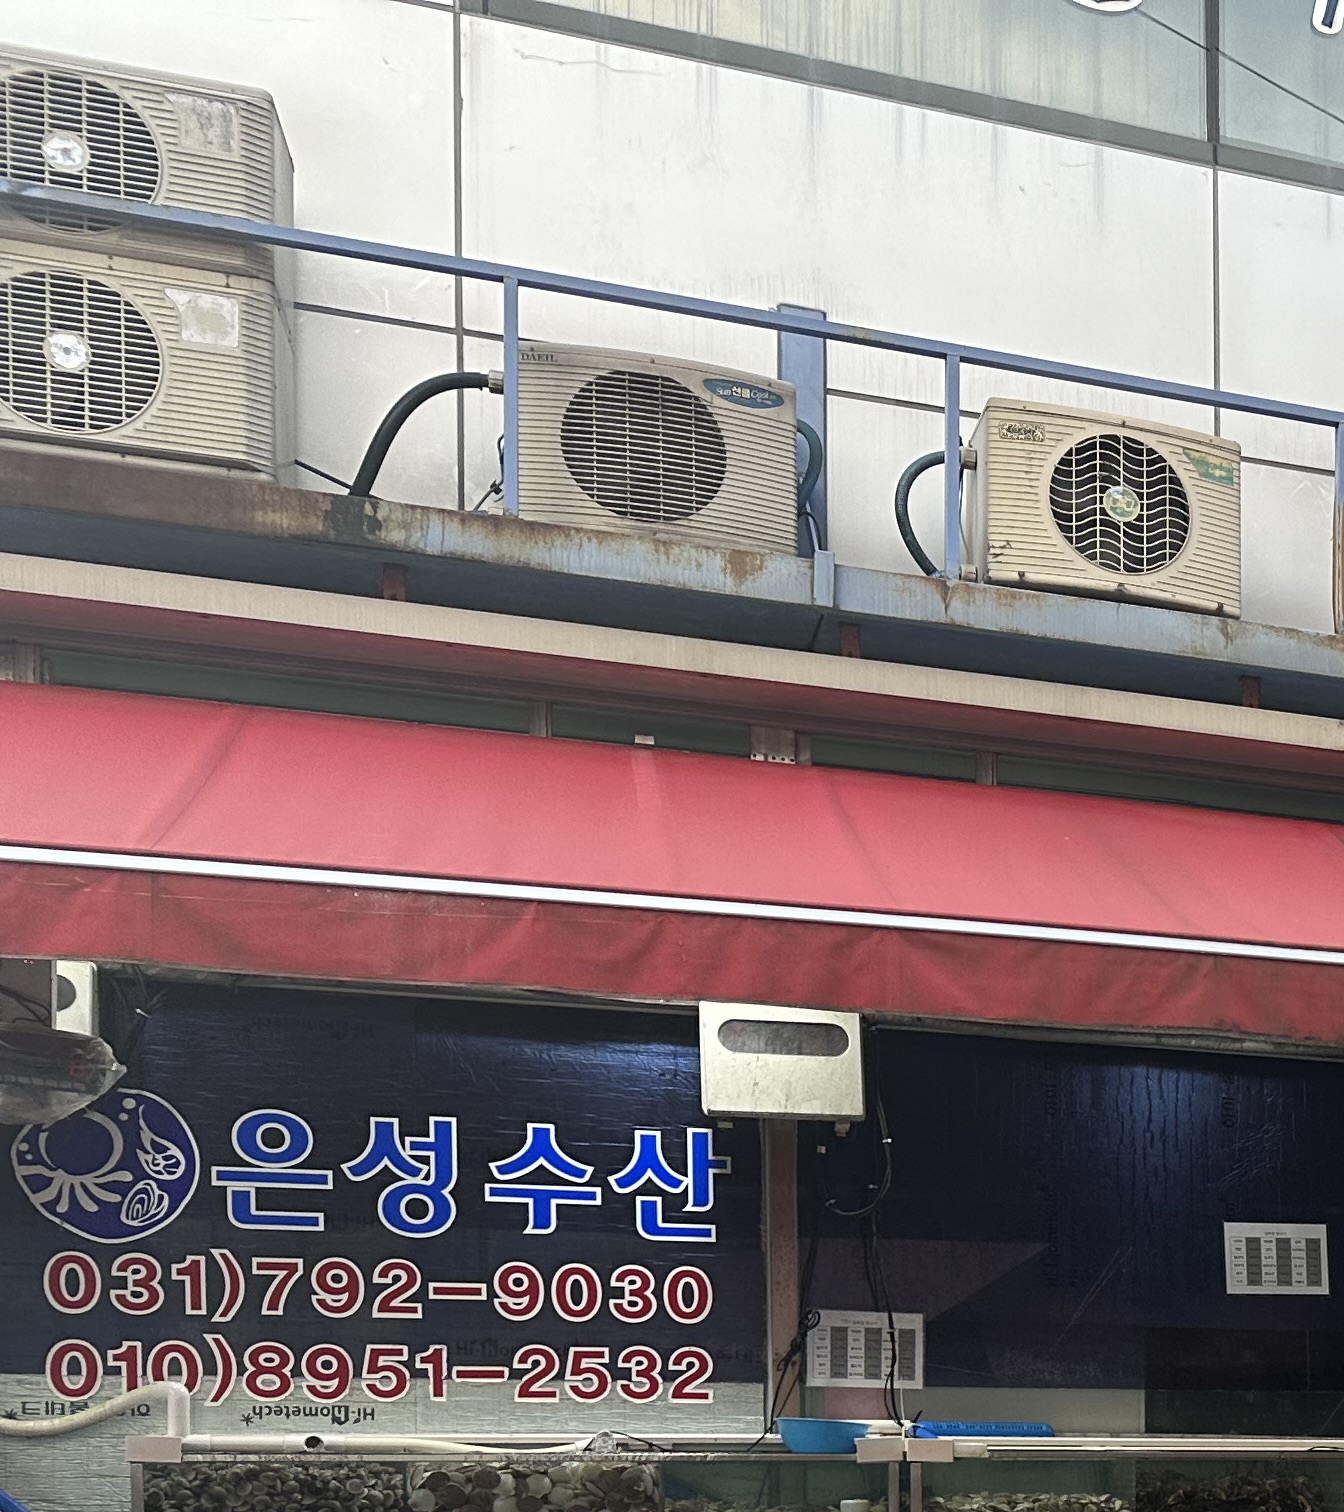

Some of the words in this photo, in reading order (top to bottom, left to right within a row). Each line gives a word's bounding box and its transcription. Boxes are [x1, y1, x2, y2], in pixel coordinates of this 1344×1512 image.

[520, 352, 558, 363] DAEIL
[210, 1108, 733, 1244] 은성수산
[42, 1248, 715, 1325] 031)792-9030
[44, 1333, 716, 1406] 010)8951-2532
